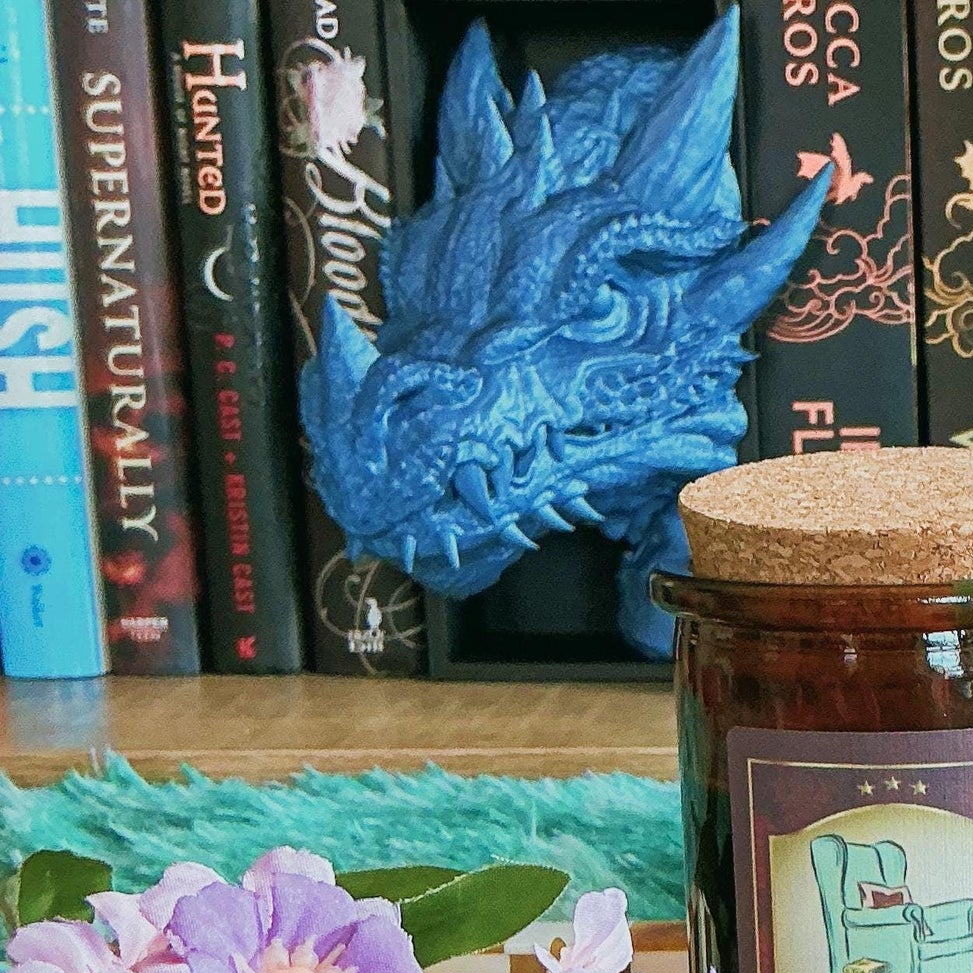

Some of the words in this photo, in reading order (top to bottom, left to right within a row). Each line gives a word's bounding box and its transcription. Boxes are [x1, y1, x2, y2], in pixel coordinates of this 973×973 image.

[783, 0, 819, 87] ROS
[936, 0, 973, 91] ROS
[81, 71, 159, 542] SUPERNATURALLY
